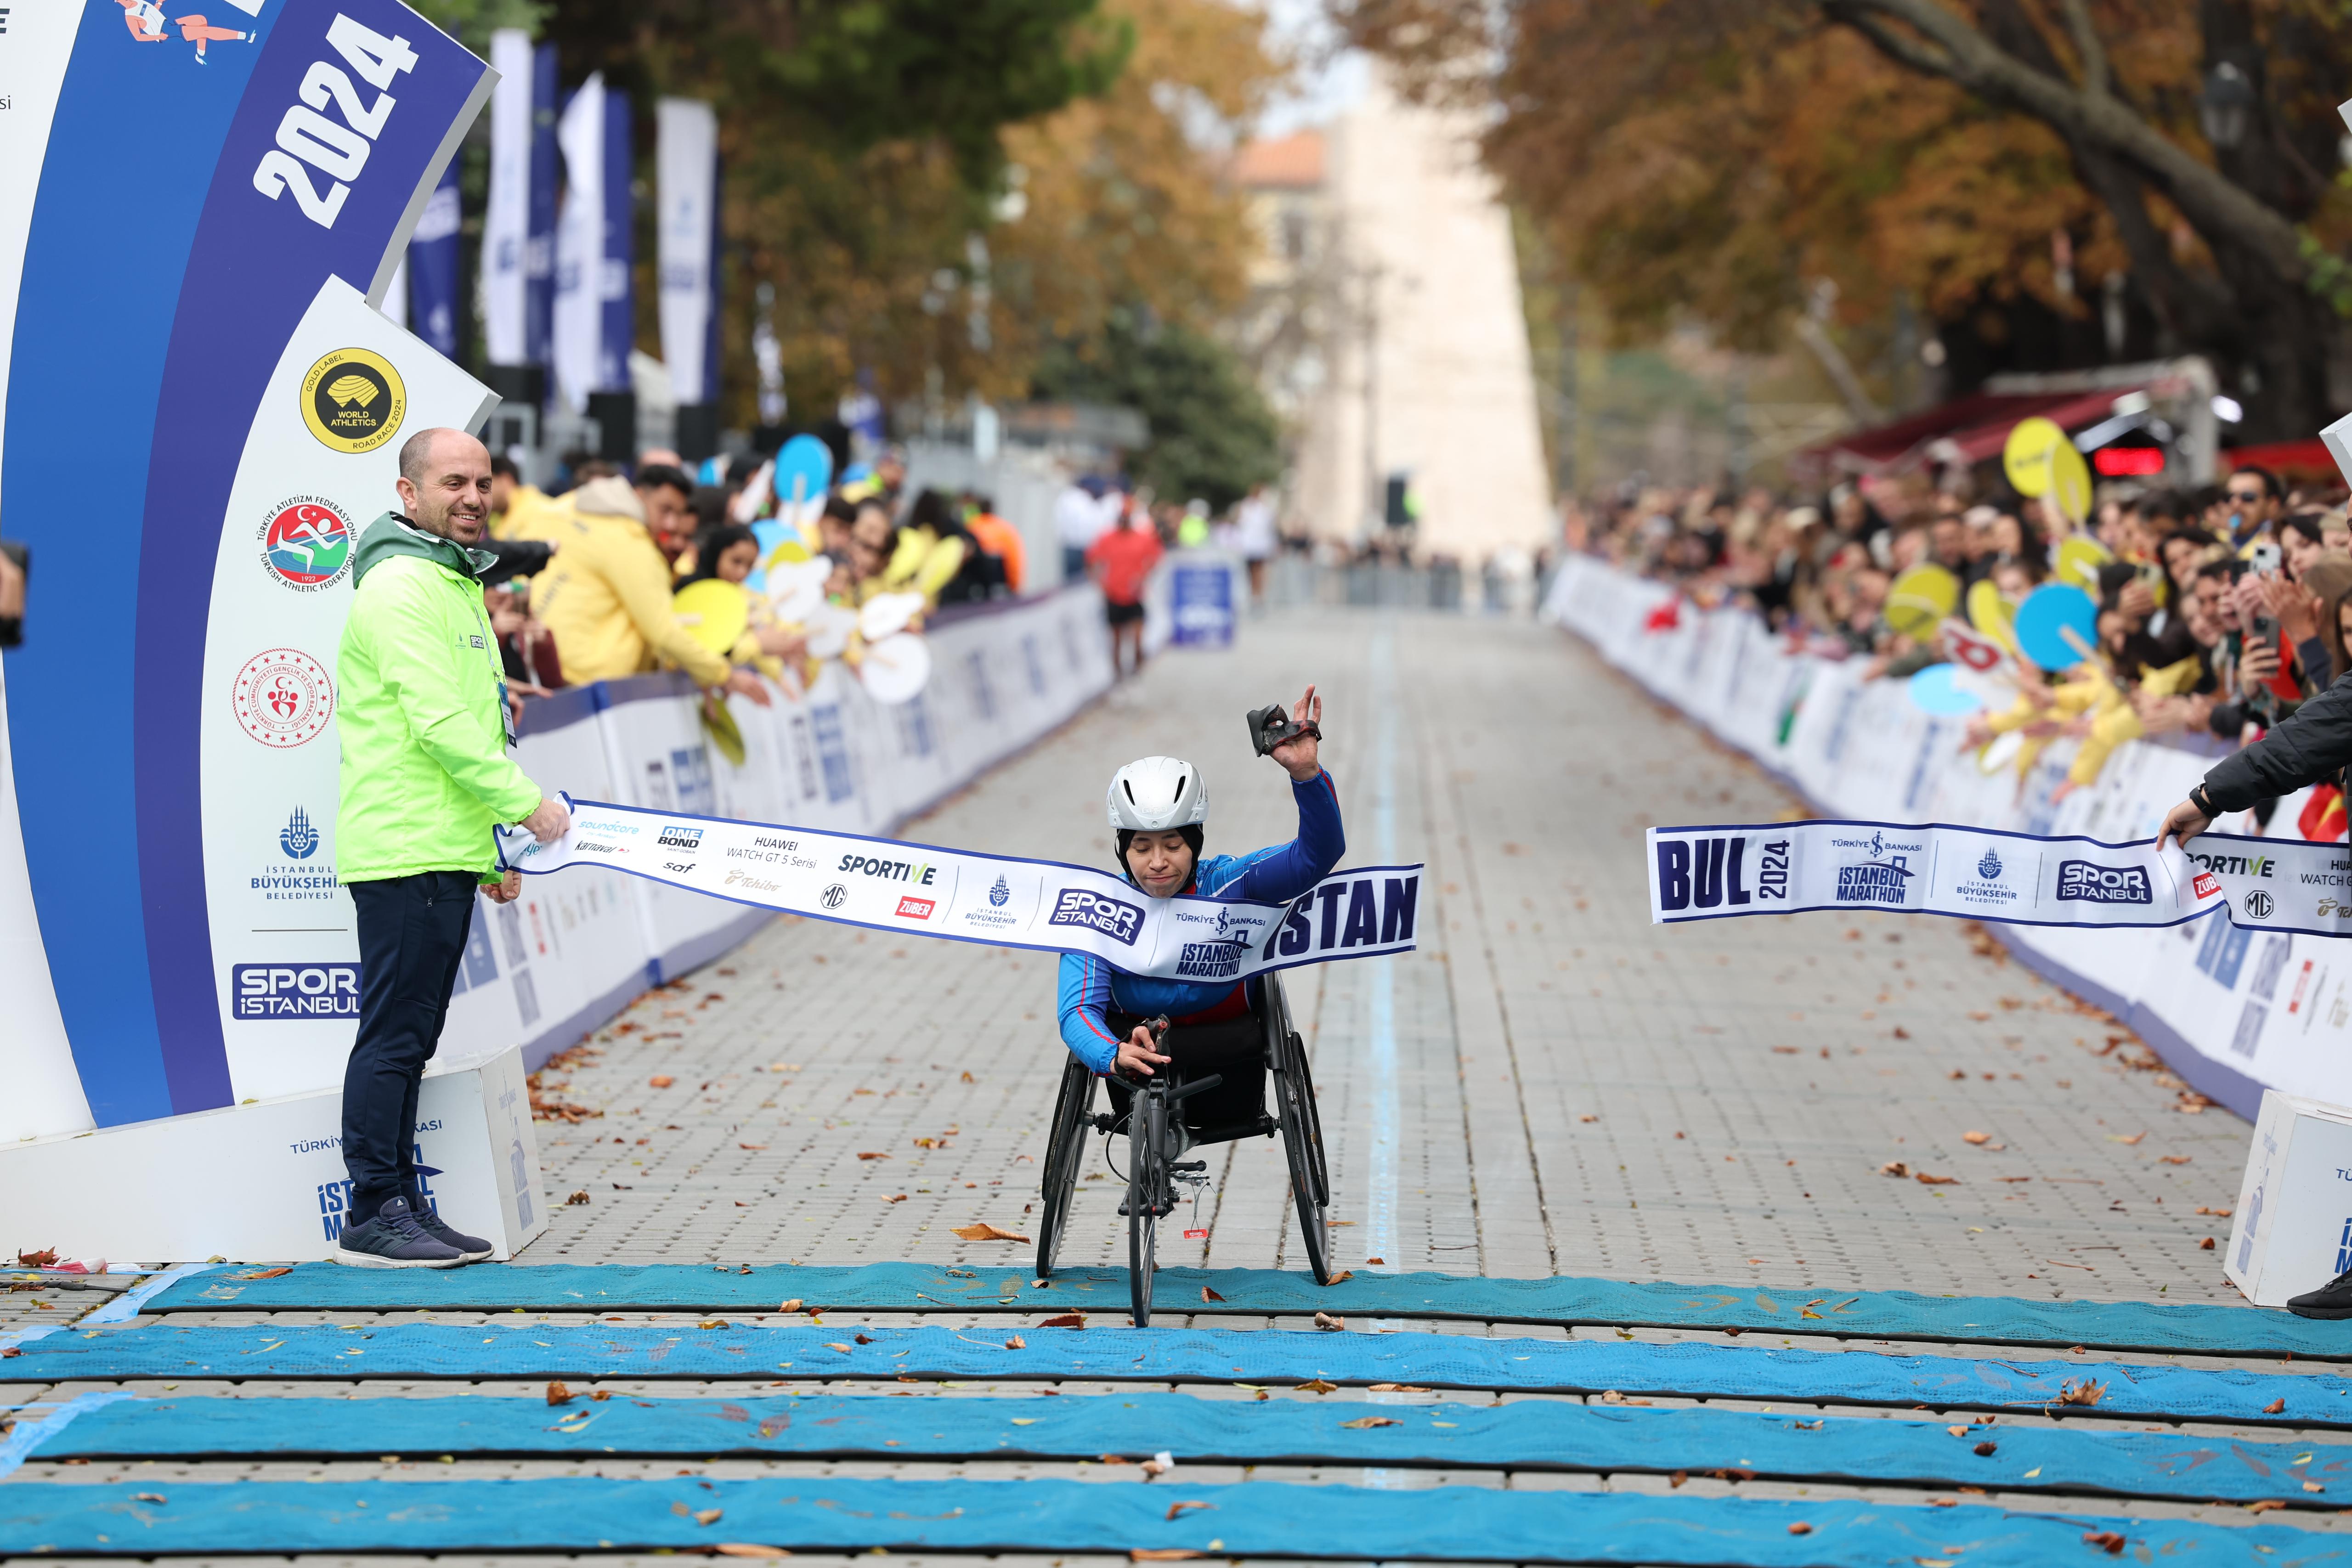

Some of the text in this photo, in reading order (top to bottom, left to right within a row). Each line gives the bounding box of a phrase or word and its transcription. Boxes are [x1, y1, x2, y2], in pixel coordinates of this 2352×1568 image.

[253, 12, 419, 230] 2024
[306, 354, 344, 392] GOLD LABEL
[353, 400, 401, 449] ROAD RACE 2024
[256, 494, 358, 541] TÜRKİYE ATLETİZM FEDERASYONU
[260, 552, 355, 592] TURKISH ATHLETIC FEDERATION
[251, 666, 315, 729] TÜRKİYE CUMHURİYETİ GENÇLİK VE SPOR BAKANLIĞI
[578, 821, 639, 834] soundcore
[664, 828, 701, 839] ONE
[575, 840, 617, 853] karnaval
[657, 837, 699, 848] BOND
[754, 837, 798, 851] HUAWEI
[1832, 839, 1869, 847] TÜRKİYE
[727, 847, 817, 869] WATCH GT 5 Serisi
[2185, 853, 2275, 877] ORTIVE
[663, 862, 696, 873] saf
[838, 855, 936, 885] SPORTIVE
[1657, 838, 1750, 910] BUL
[1759, 840, 1790, 898] 2024
[2064, 864, 2146, 889] SPOR
[741, 877, 782, 891] Tchibo
[1967, 880, 2008, 889] İSTANBUL
[2196, 876, 2219, 894] ZÜB
[2301, 874, 2343, 886] WATCH
[266, 891, 333, 900] BELEDİYESİ
[822, 886, 846, 908] MG
[1837, 886, 1905, 903] MARATHON
[1956, 887, 2017, 900] BÜYÜKŞEHİR
[1965, 897, 2007, 905] BELEDİYESİ
[899, 901, 931, 916] ZÜBER
[977, 908, 1012, 916] İSTANBUL
[1059, 893, 1137, 929] SPOR
[2246, 891, 2272, 917] MG
[965, 913, 1016, 925] BÜYÜKŞEHİR
[1176, 913, 1215, 924] TÜRKİYE
[1230, 918, 1265, 926] BANKASI
[1176, 959, 1240, 977] MARATONU
[241, 968, 359, 995] SPOR
[290, 1135, 343, 1154] TÜRKİY
